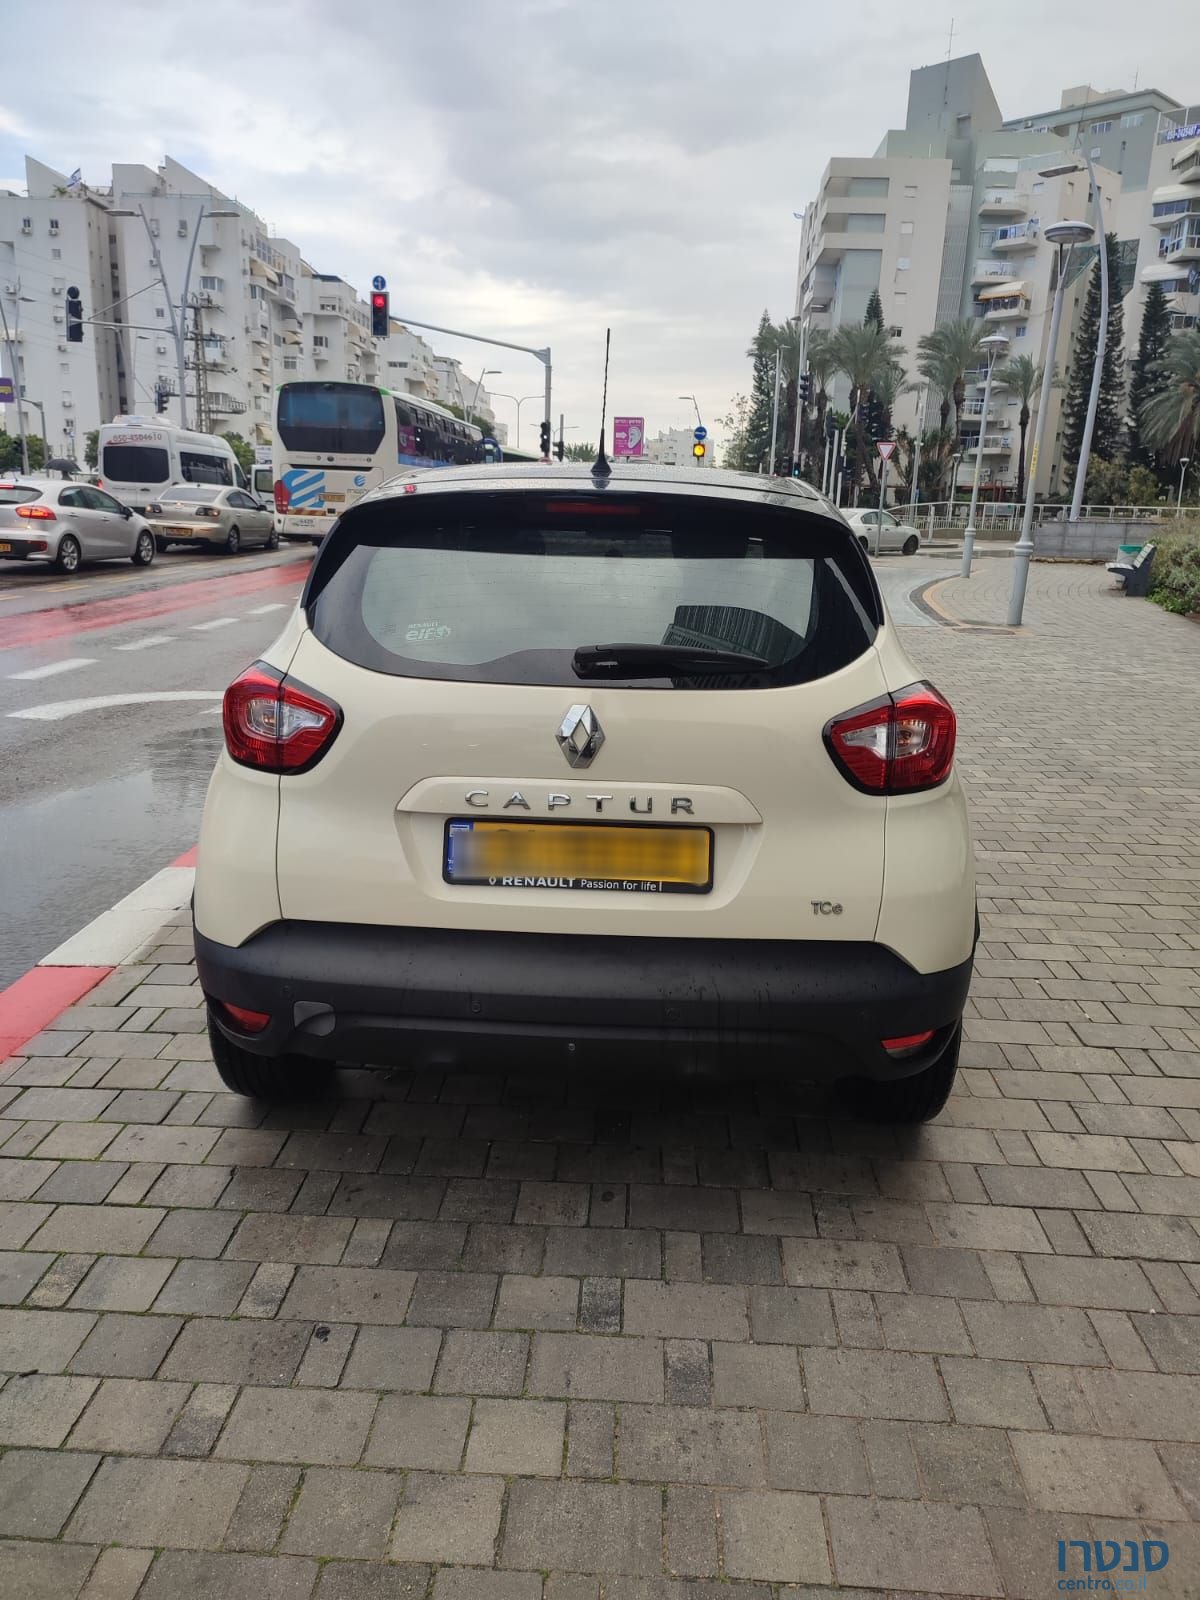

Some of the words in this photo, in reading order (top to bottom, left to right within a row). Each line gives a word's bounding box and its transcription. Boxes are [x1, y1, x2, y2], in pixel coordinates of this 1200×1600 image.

[464, 790, 695, 815] CAPTUR
[502, 876, 576, 888] RENAULT
[580, 879, 620, 890] Passion
[622, 881, 636, 890] for
[641, 881, 657, 892] life
[811, 900, 843, 915] TCe
